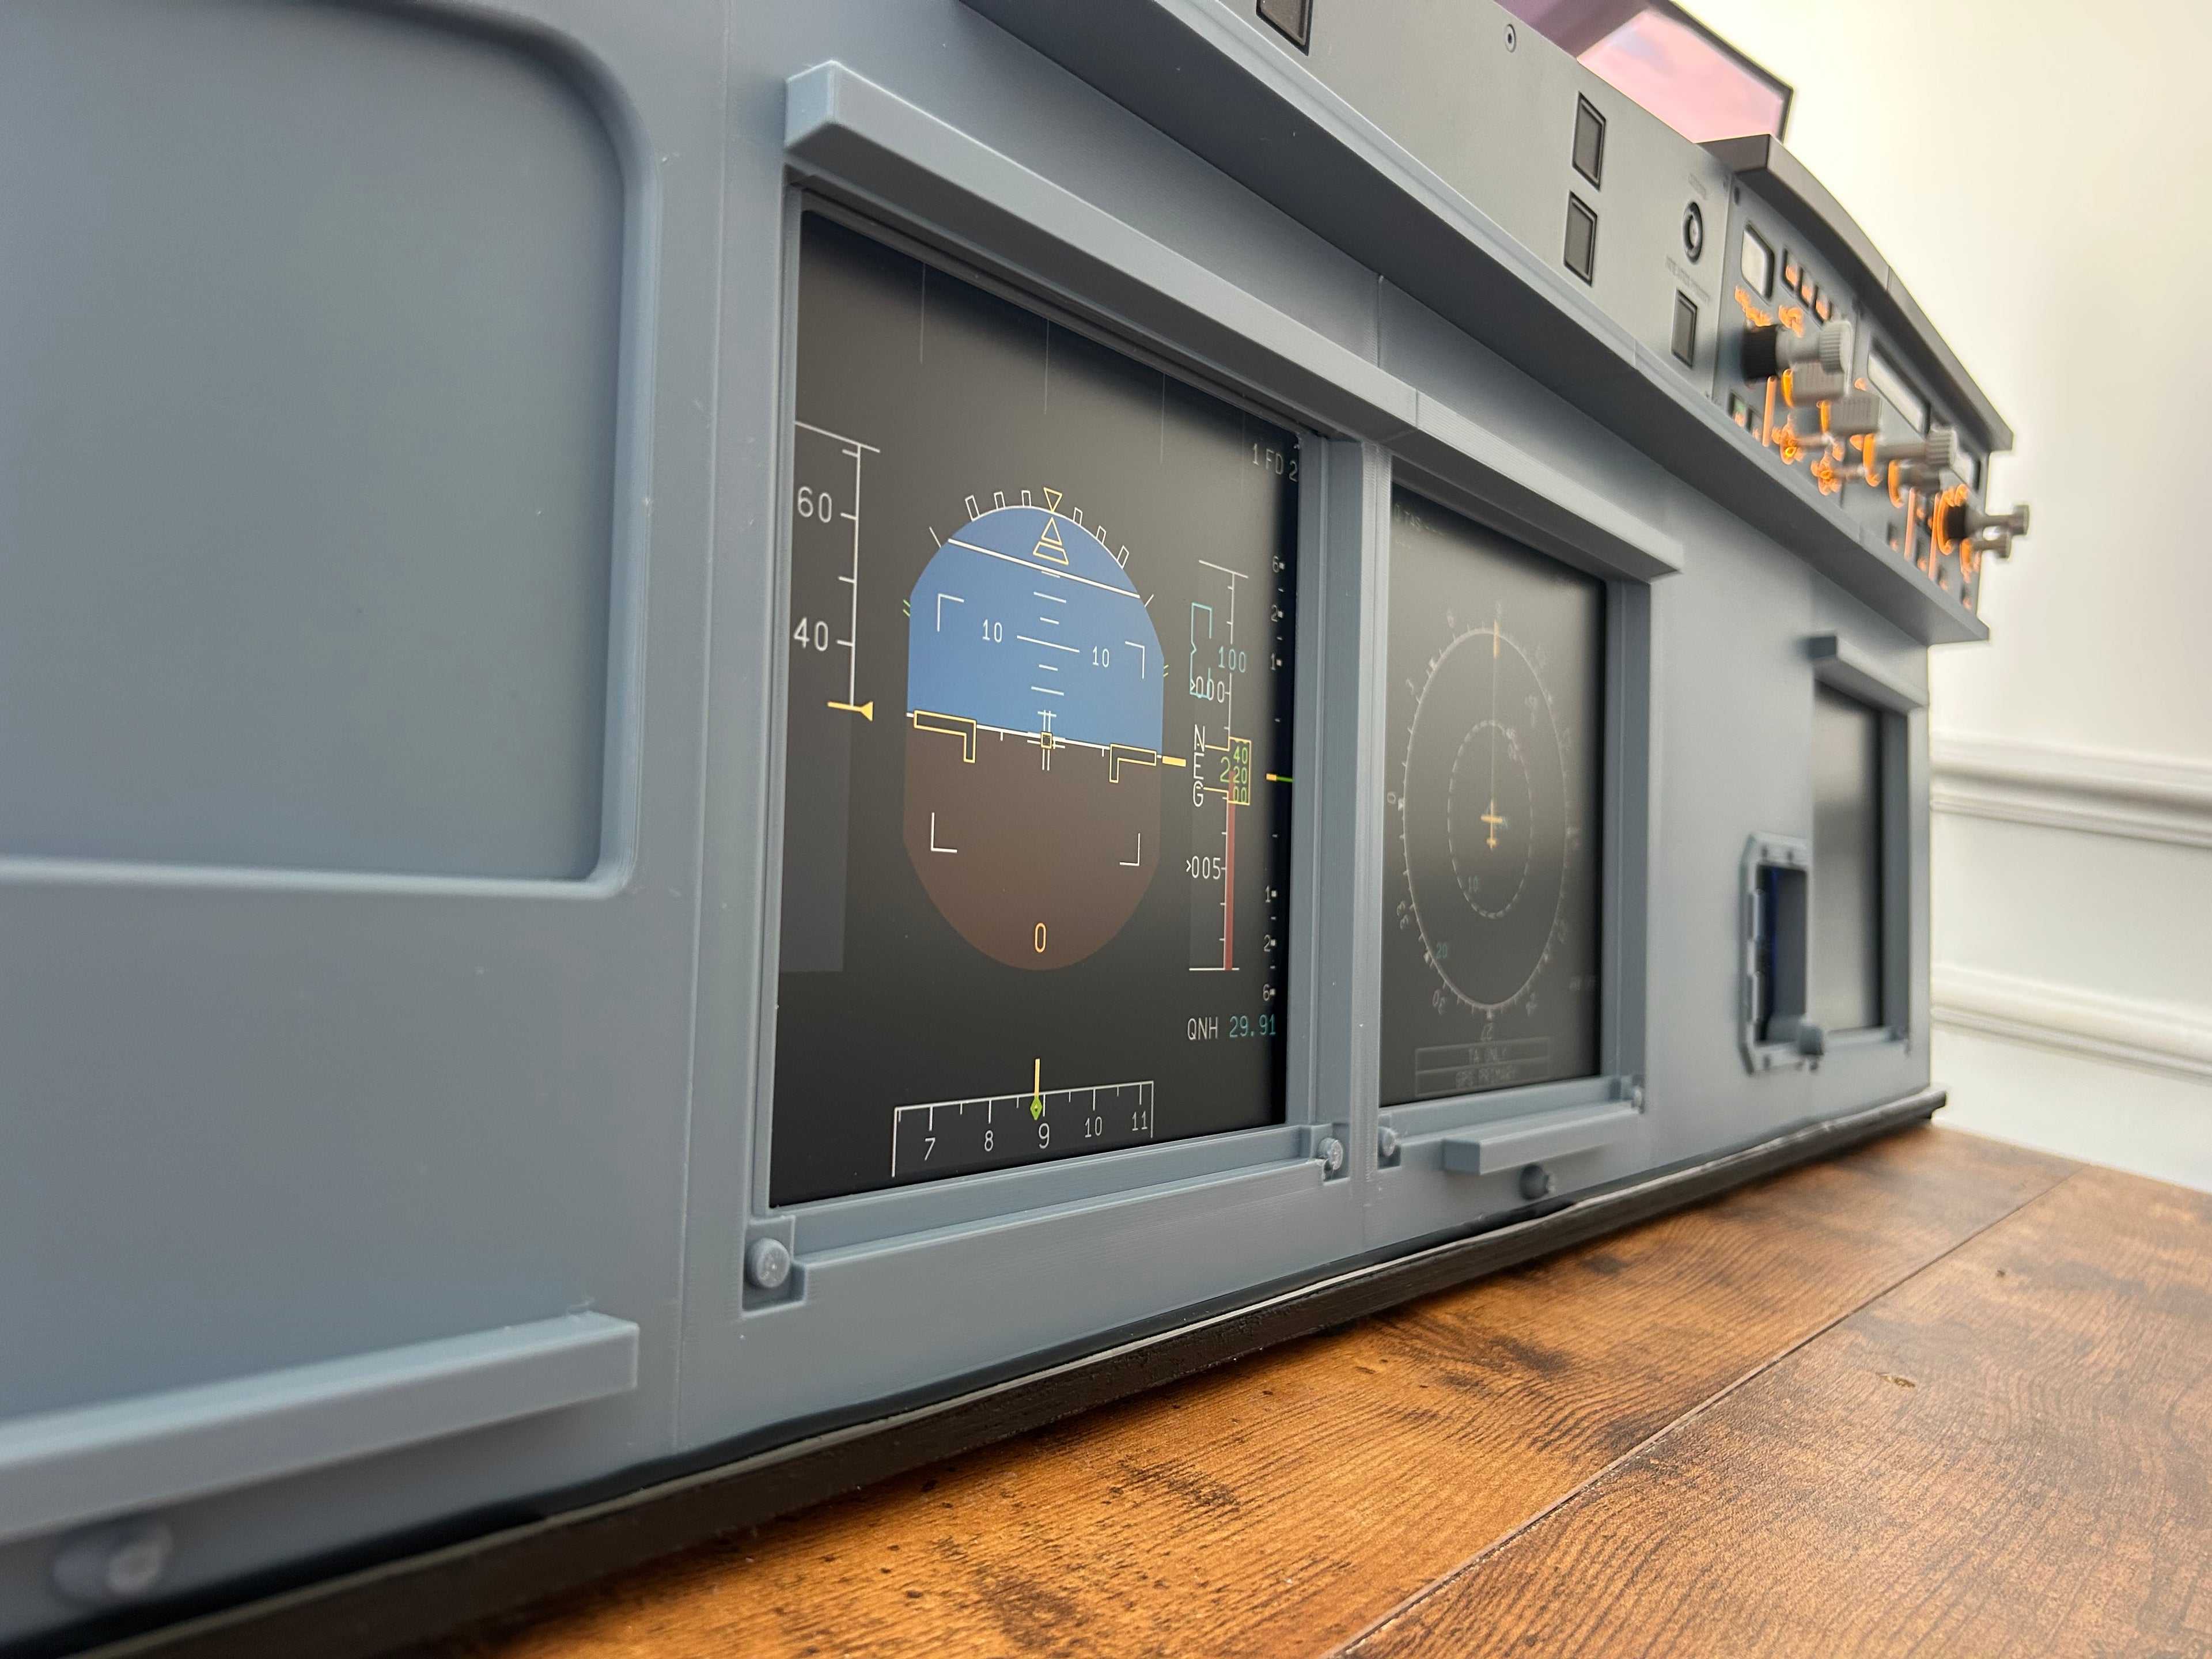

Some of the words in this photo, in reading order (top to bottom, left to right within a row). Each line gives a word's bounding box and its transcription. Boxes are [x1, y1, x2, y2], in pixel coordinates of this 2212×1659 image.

[1252, 443, 1259, 465] 1
[1266, 448, 1283, 475] FD
[1289, 460, 1298, 482] 2
[797, 486, 832, 522] 60
[1272, 555, 1280, 573] 6
[1270, 605, 1278, 622] 2
[793, 616, 830, 652] 40
[982, 619, 1003, 643] 10
[1092, 646, 1110, 667] 10
[1218, 646, 1247, 673] 100
[1270, 653, 1276, 671] 1
[1233, 746, 1248, 764] 40
[1219, 756, 1231, 783] 2
[1233, 766, 1248, 784] 20
[1233, 786, 1247, 803] 00
[1265, 885, 1271, 903] 1
[1033, 922, 1047, 953] 0
[1263, 934, 1271, 952] 2
[1263, 984, 1271, 1001] 6
[1187, 1017, 1219, 1041] QNH
[1229, 1014, 1277, 1038] 29.91
[924, 1137, 936, 1161] 7
[984, 1130, 994, 1152] 8
[1038, 1123, 1050, 1150] 9
[1085, 1116, 1103, 1138] 10
[1131, 1111, 1148, 1131] 11
